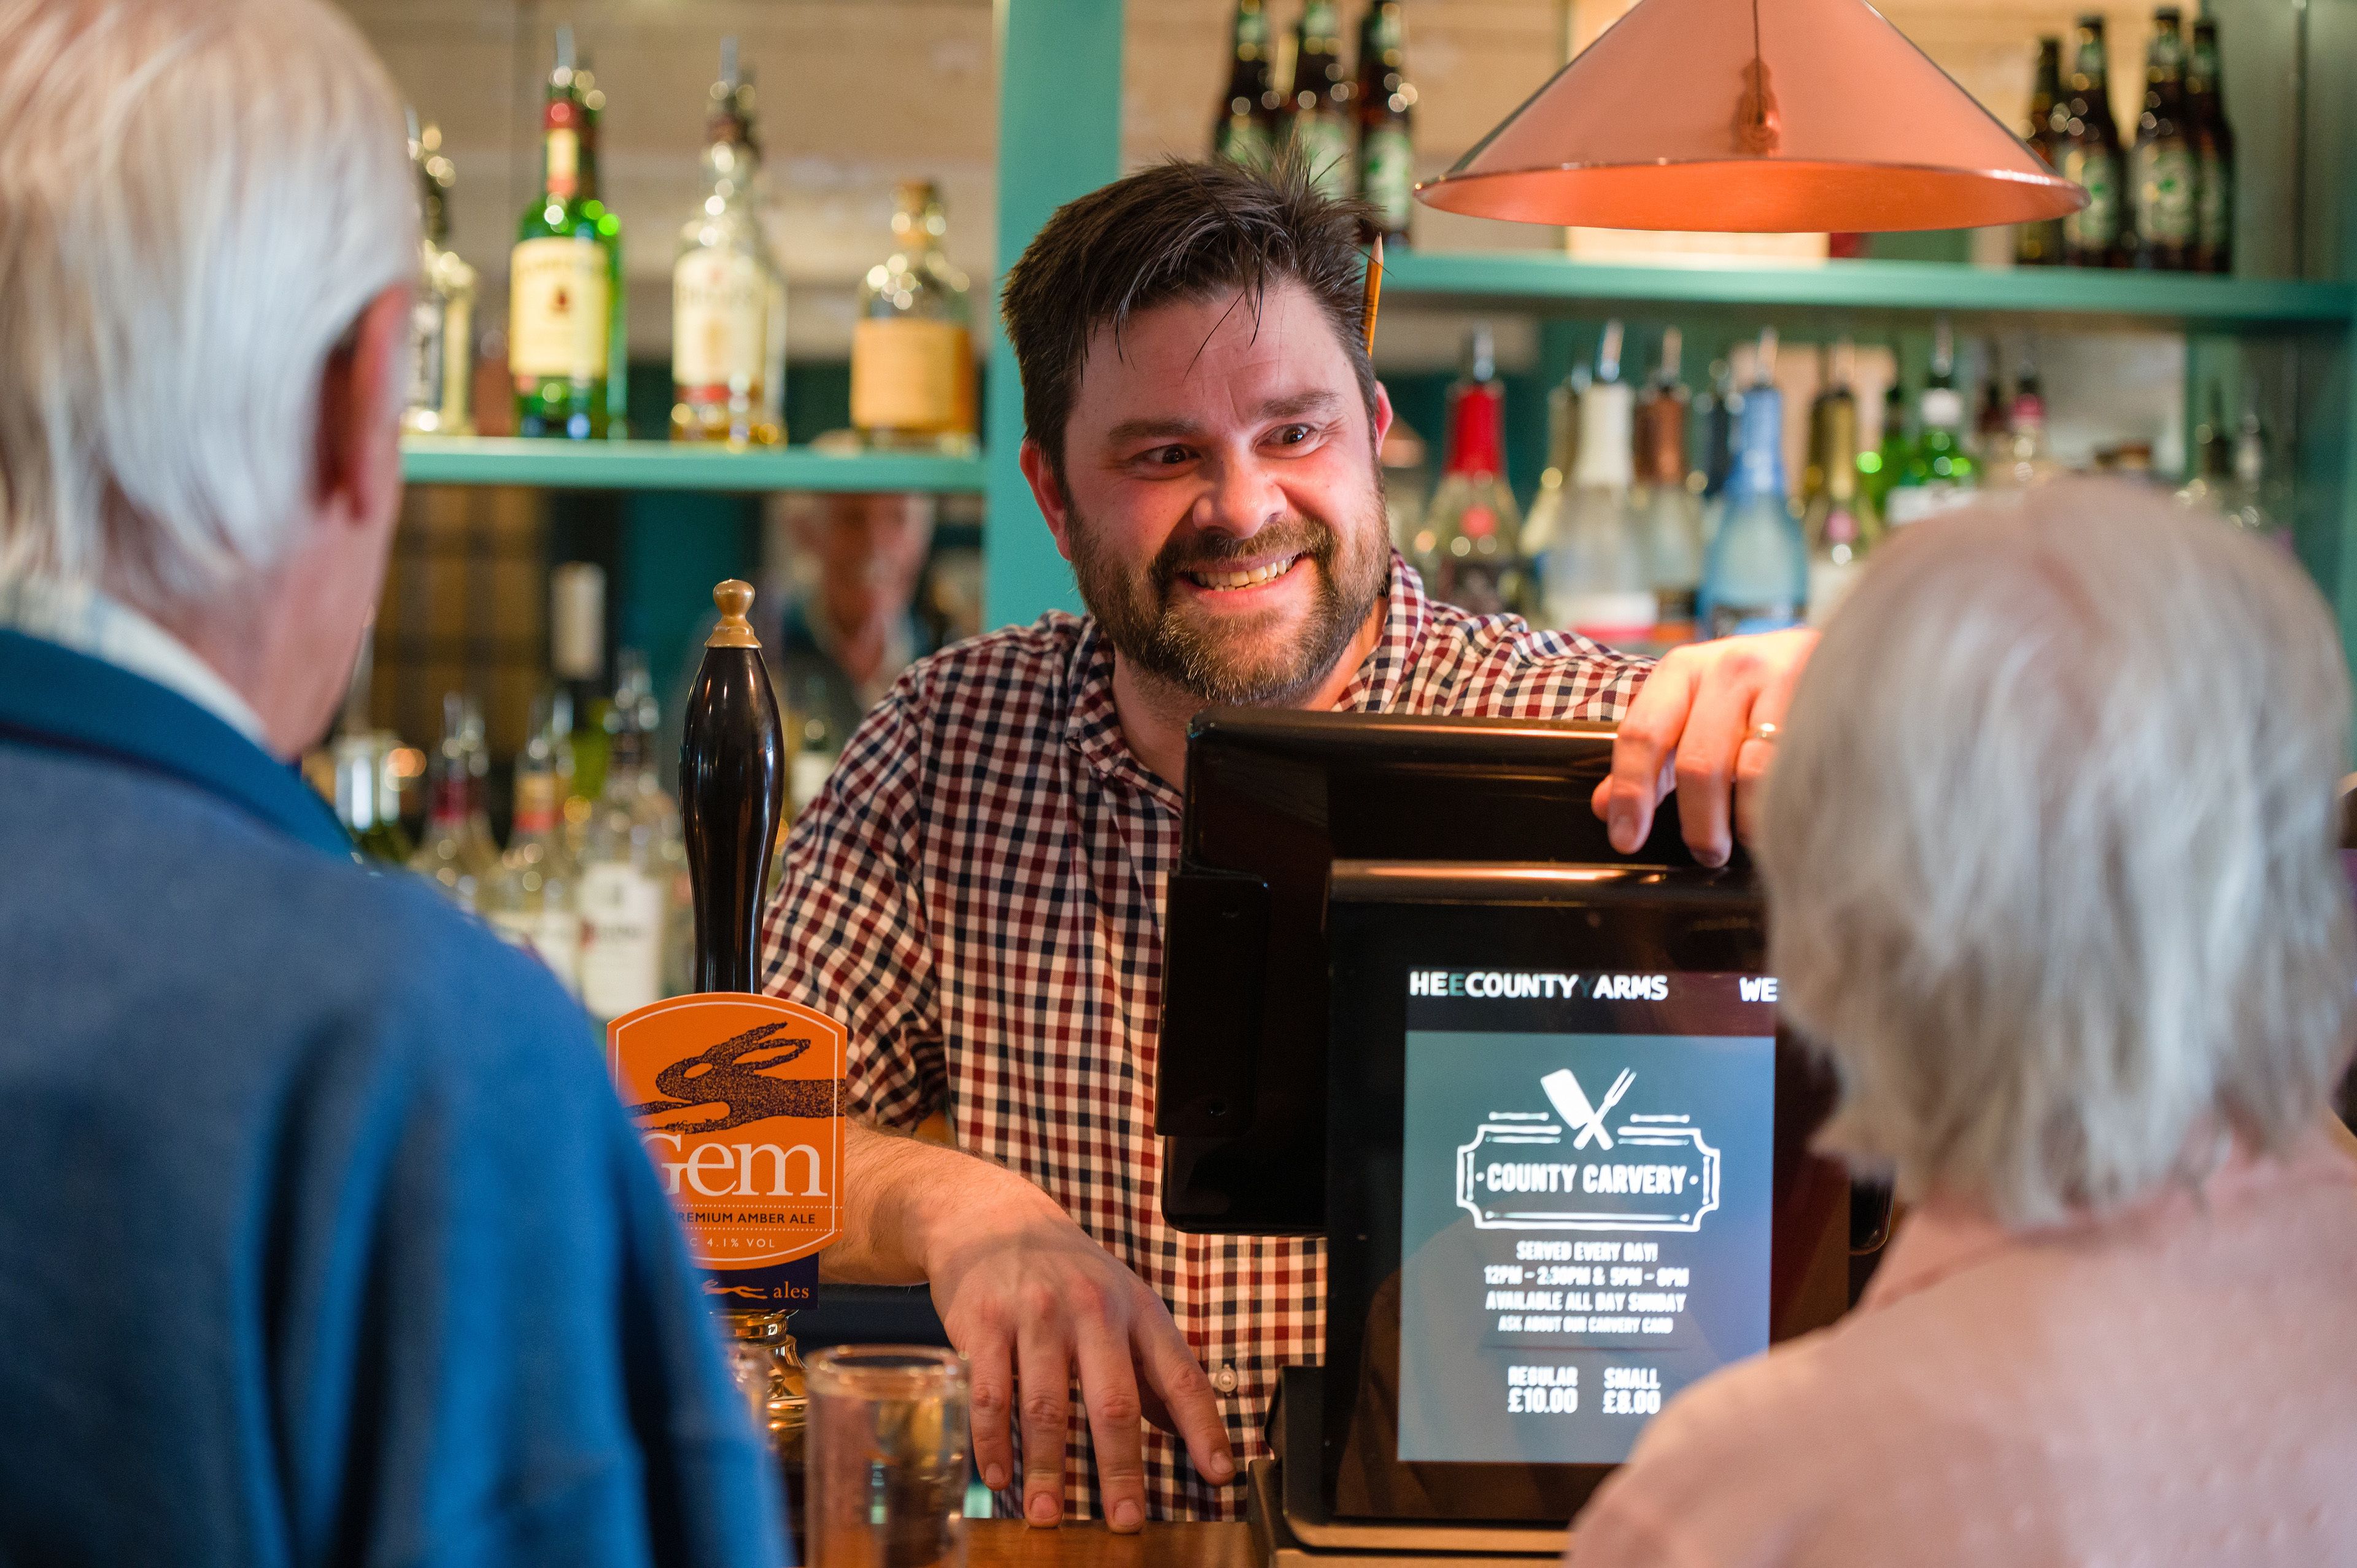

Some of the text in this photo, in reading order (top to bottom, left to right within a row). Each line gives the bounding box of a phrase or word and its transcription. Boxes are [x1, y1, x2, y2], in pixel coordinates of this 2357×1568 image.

[1465, 972, 1579, 999] COUNTY
[1593, 975, 1669, 1000] ARMS
[643, 1133, 828, 1196] Gem
[1487, 1162, 1687, 1194] COUNTY CARVERY
[676, 1212, 816, 1224] REMIUM AMBER ALE
[706, 1238, 739, 1248] 4.1%
[746, 1238, 775, 1248] VOL
[1516, 1240, 1572, 1261] SERVED
[1574, 1241, 1622, 1261] EVERY
[773, 1281, 809, 1299] ales
[1485, 1291, 1687, 1312] AVAILABLE ALL DAY SUNDAY
[1507, 1365, 1578, 1387] REGULAR
[1603, 1367, 1661, 1389] SMALL
[1507, 1386, 1578, 1413] £10.00
[1602, 1389, 1661, 1415] £8.00
